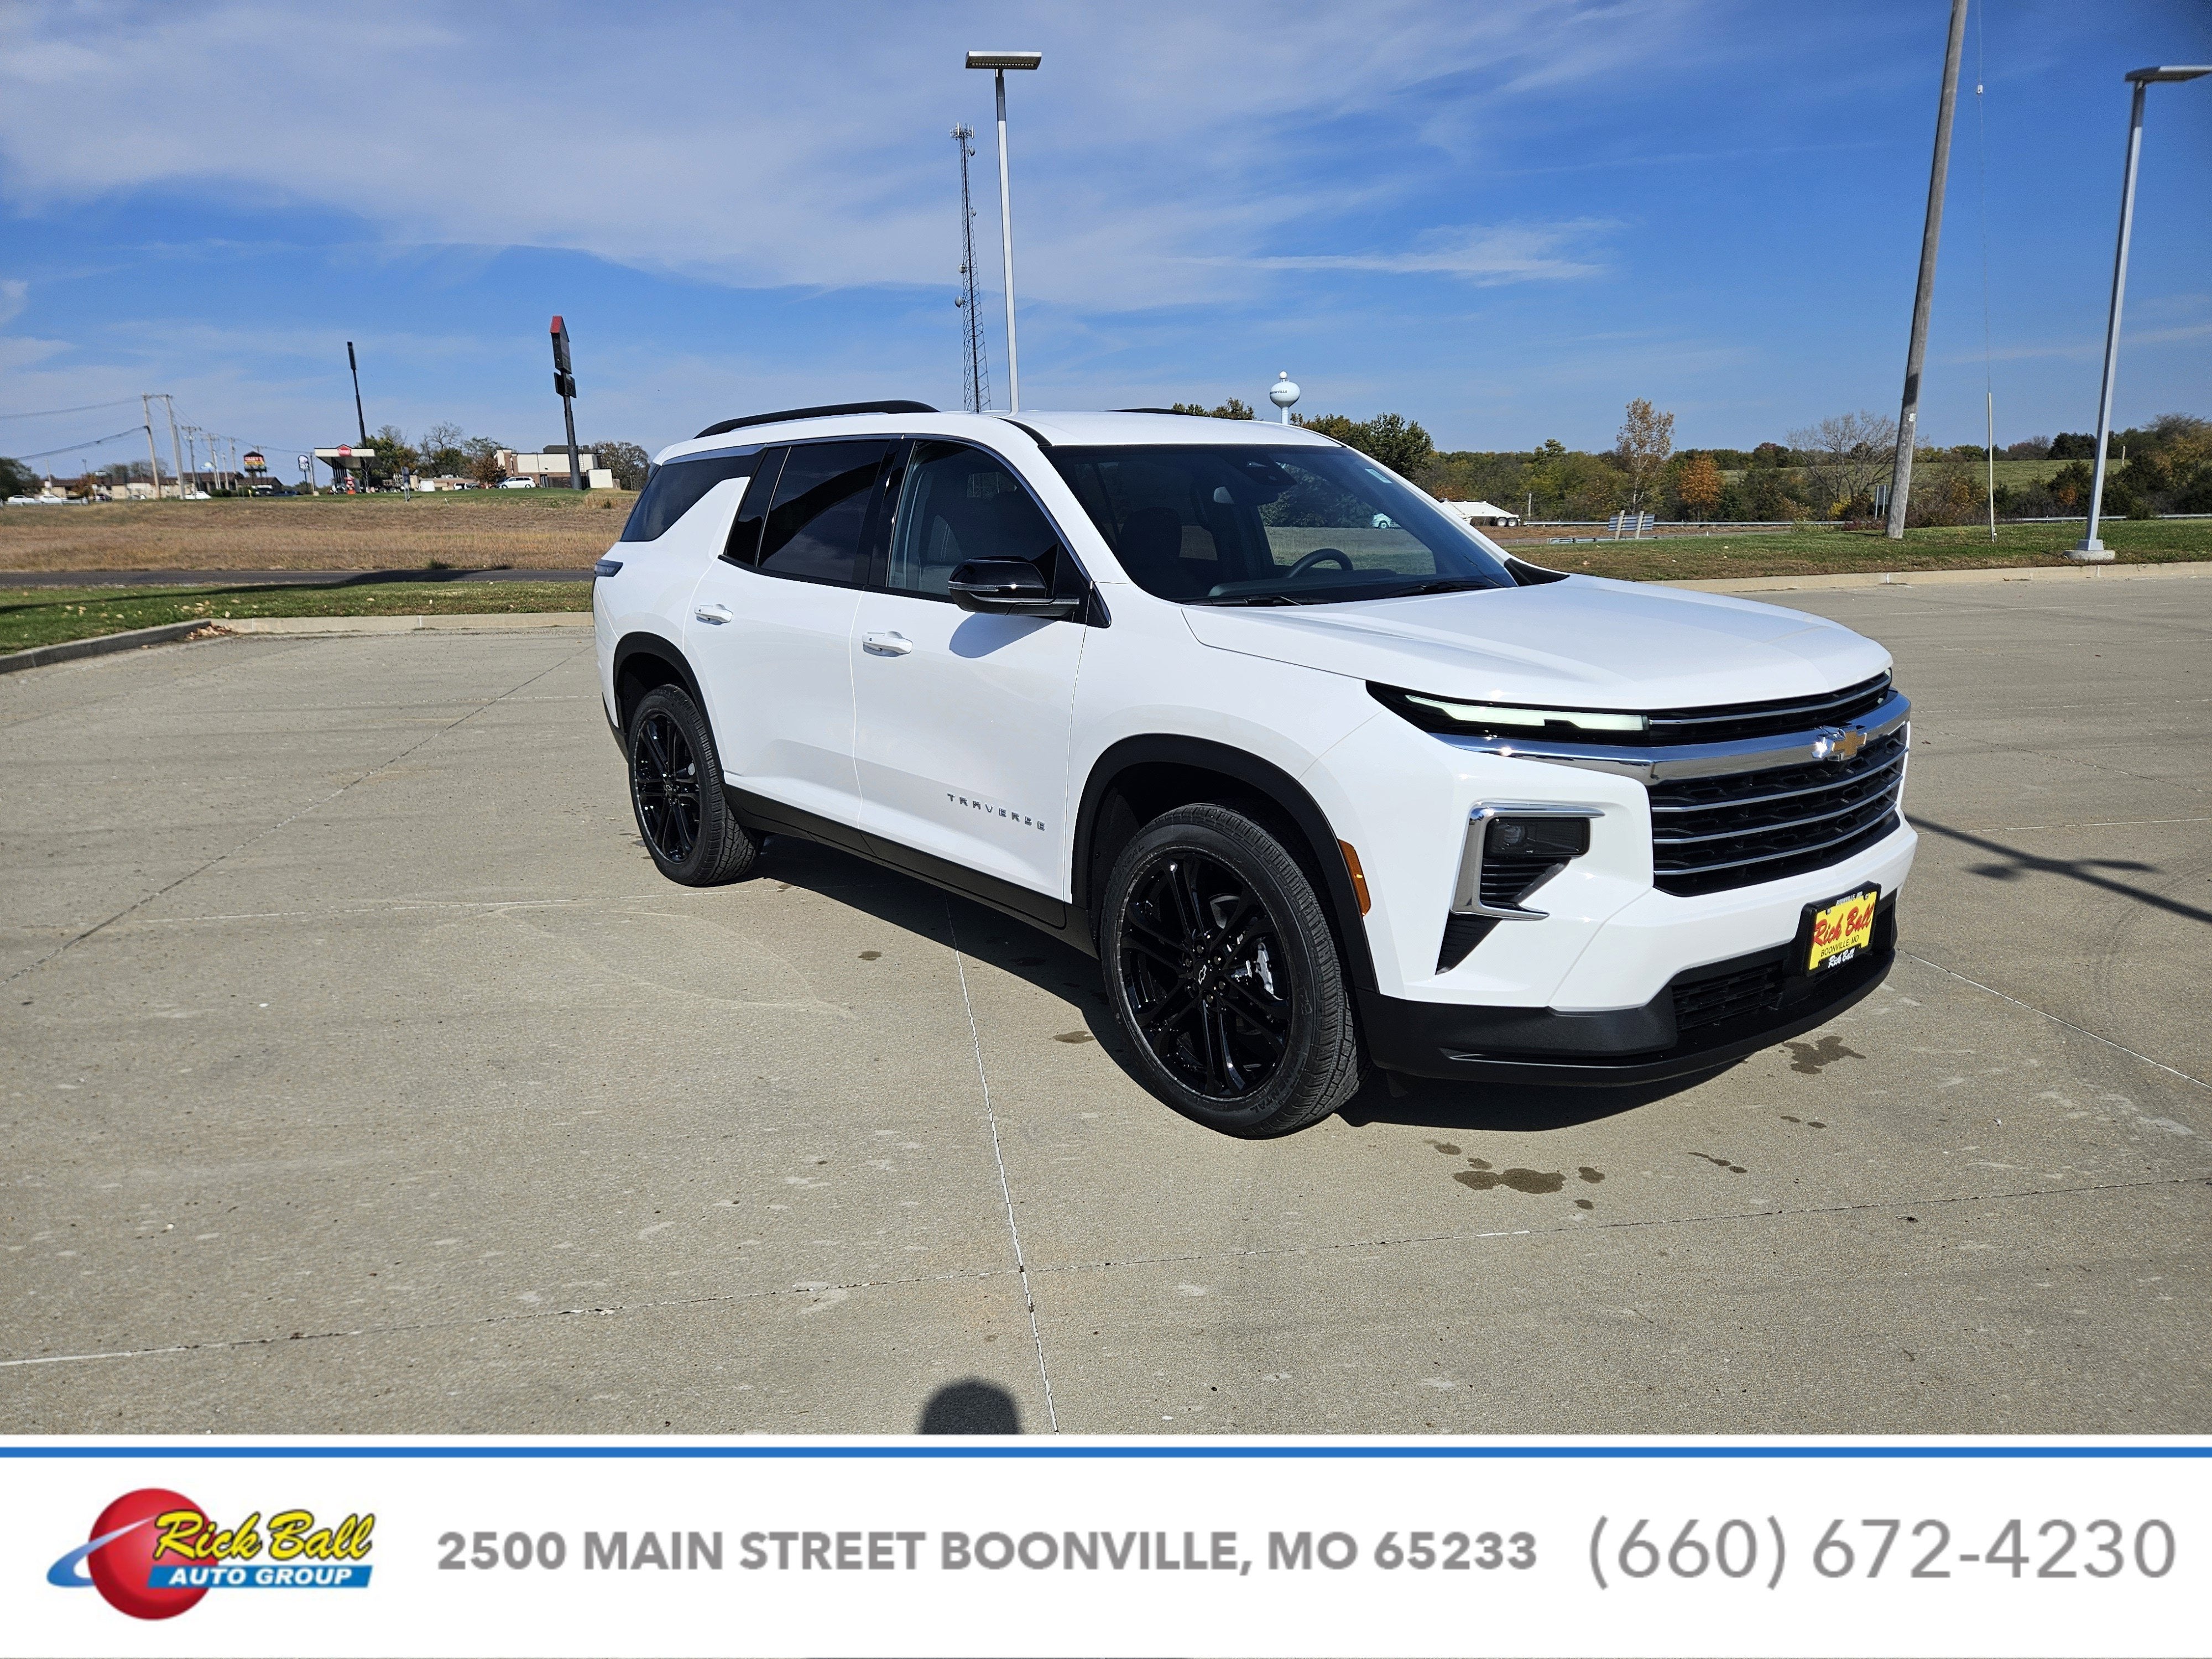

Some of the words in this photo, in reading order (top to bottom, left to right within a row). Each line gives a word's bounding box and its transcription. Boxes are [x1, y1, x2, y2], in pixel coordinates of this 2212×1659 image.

[947, 792, 1045, 831] TRAVERSE
[1814, 913, 1844, 947] Rick
[1845, 902, 1875, 937] Ball
[1851, 935, 1859, 945] MO
[1828, 952, 1842, 968] Rick
[1842, 947, 1855, 962] Ball
